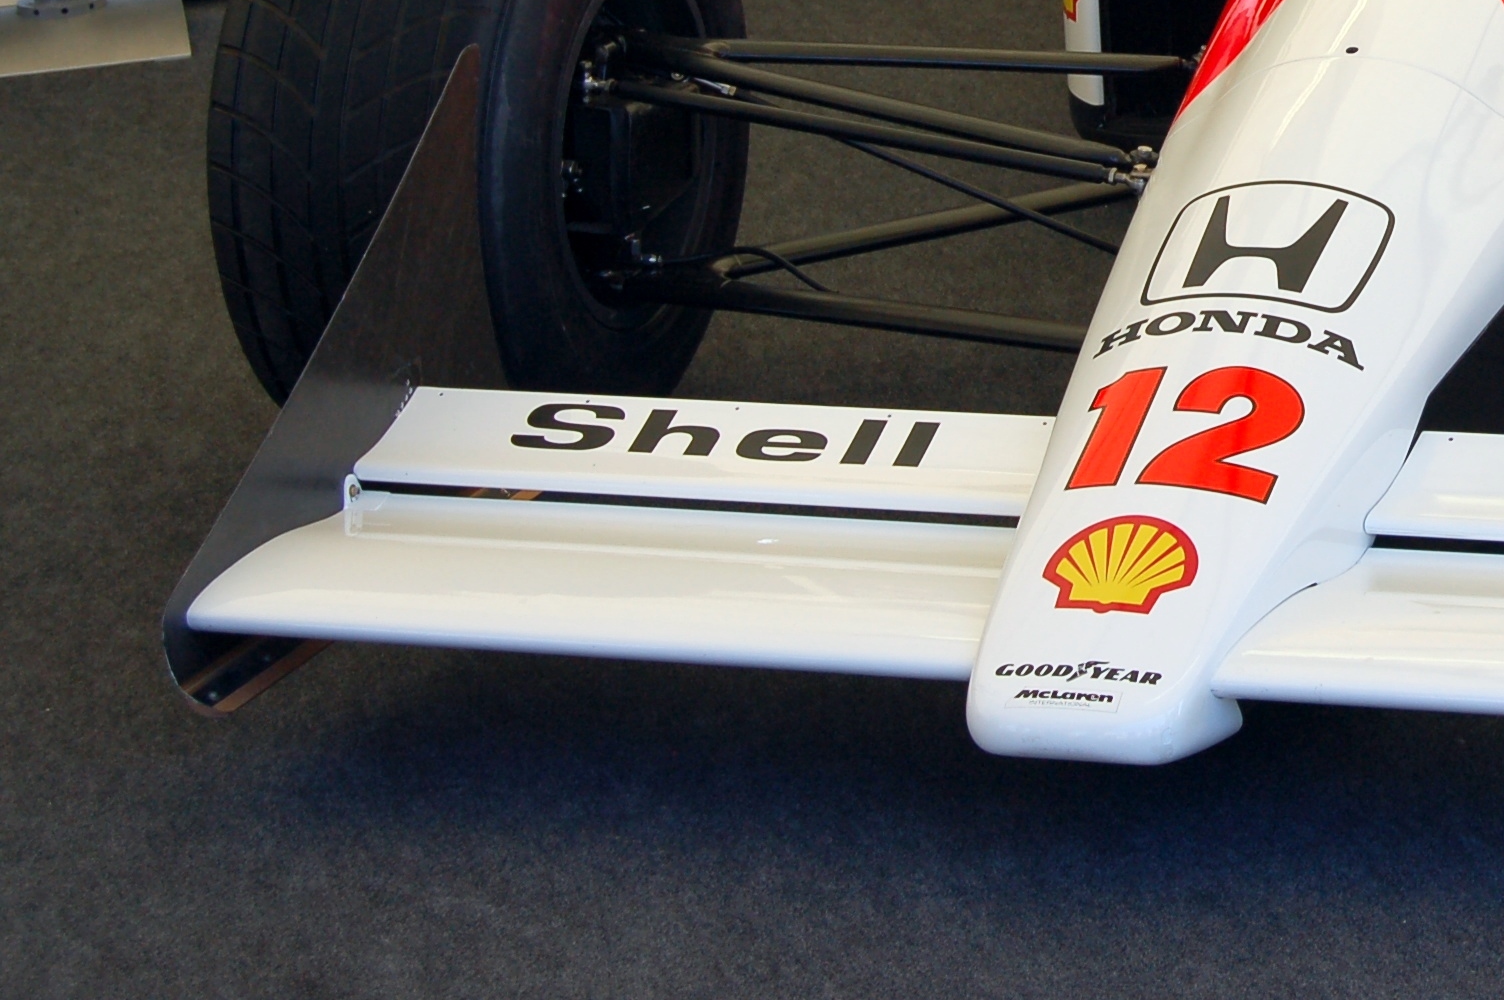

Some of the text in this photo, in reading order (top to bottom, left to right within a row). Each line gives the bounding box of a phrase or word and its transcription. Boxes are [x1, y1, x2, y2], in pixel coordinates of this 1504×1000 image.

[1093, 309, 1364, 371] HONDA
[510, 402, 941, 468] Shell
[1064, 365, 1305, 505] 12
[995, 661, 1162, 685] GOODYEAR
[1014, 689, 1114, 703] McLaren
